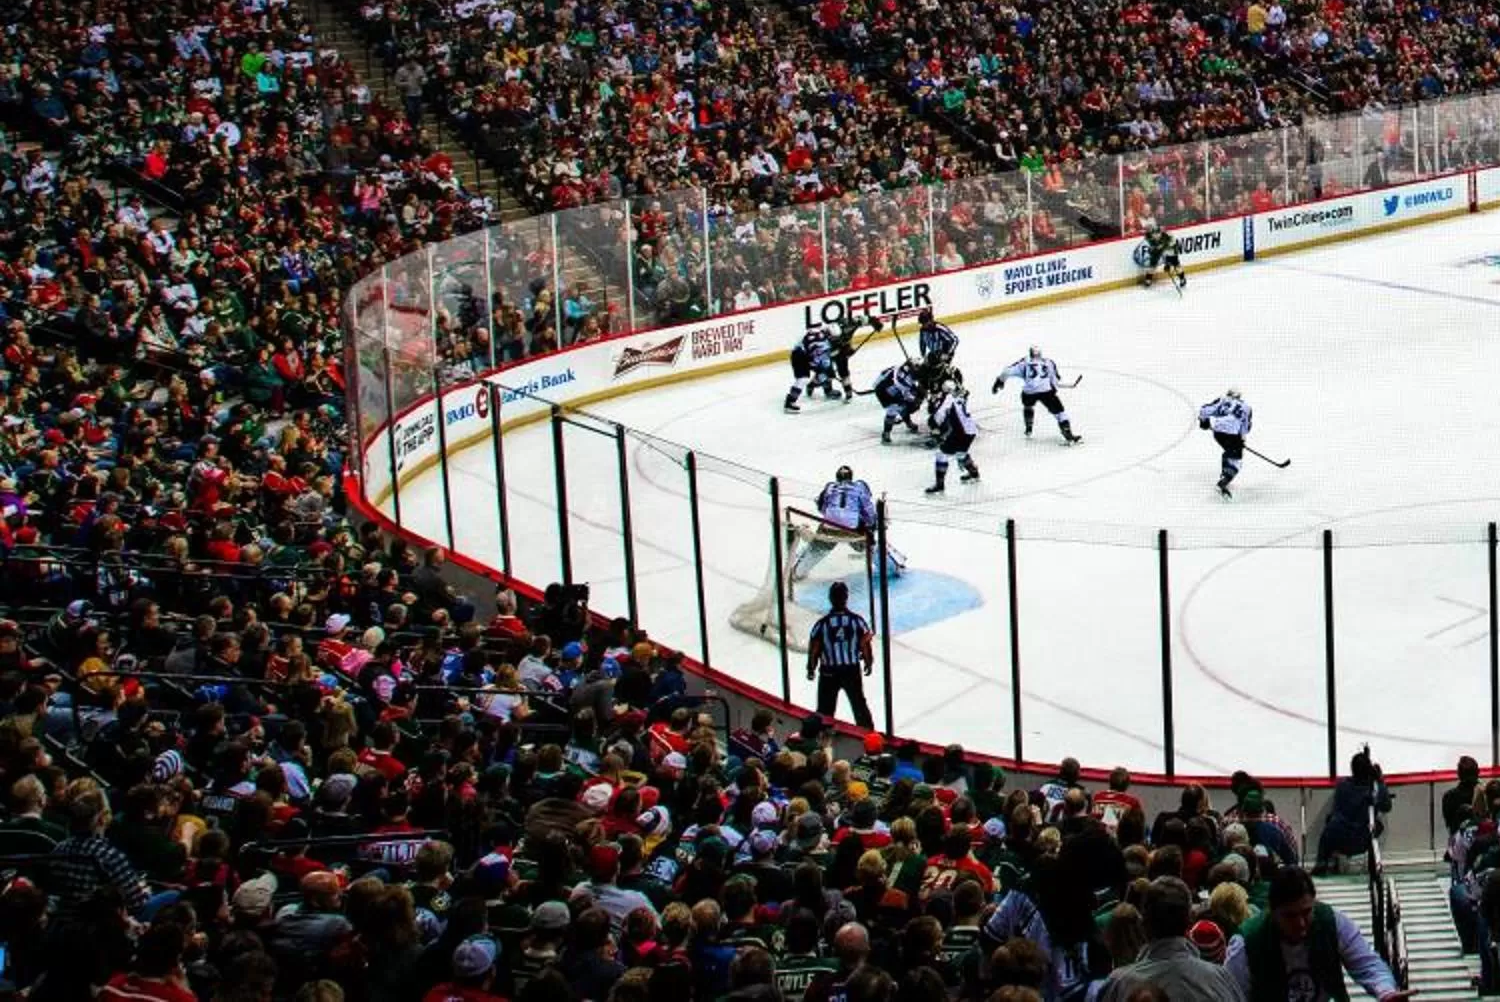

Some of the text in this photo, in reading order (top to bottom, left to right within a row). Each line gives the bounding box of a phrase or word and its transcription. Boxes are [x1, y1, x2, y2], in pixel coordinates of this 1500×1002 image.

[1175, 233, 1221, 255] NORTH
[1004, 258, 1067, 281] MAYO CLINIC
[1004, 265, 1093, 295] SPORTS MEDICINE
[804, 283, 933, 329] LOFFLER
[691, 320, 756, 345] BREWED THE
[501, 367, 577, 405] arris Bank
